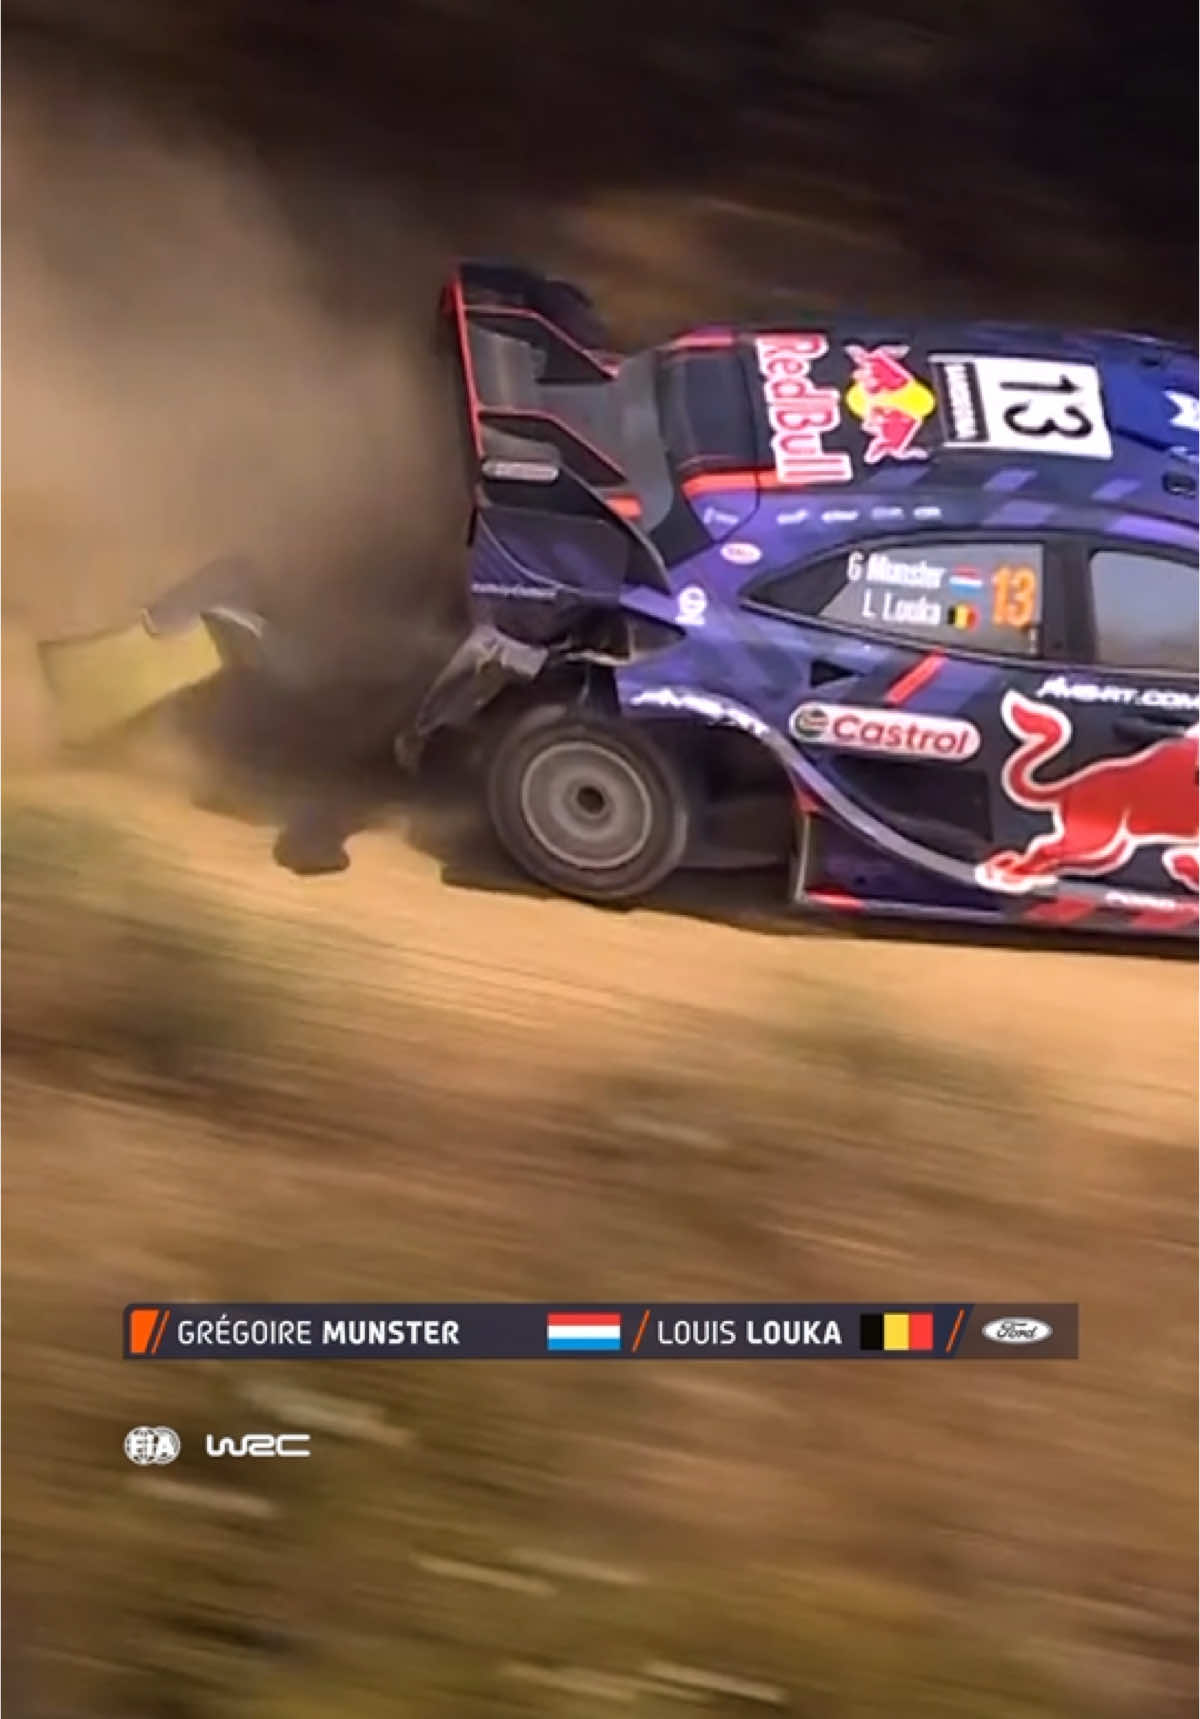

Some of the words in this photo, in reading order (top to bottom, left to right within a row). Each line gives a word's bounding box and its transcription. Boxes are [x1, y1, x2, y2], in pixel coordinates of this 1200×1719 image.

[1000, 374, 1092, 439] 13
[847, 552, 864, 581] G
[862, 589, 876, 618] L
[992, 566, 1036, 627] 13
[833, 714, 971, 756] Castrol
